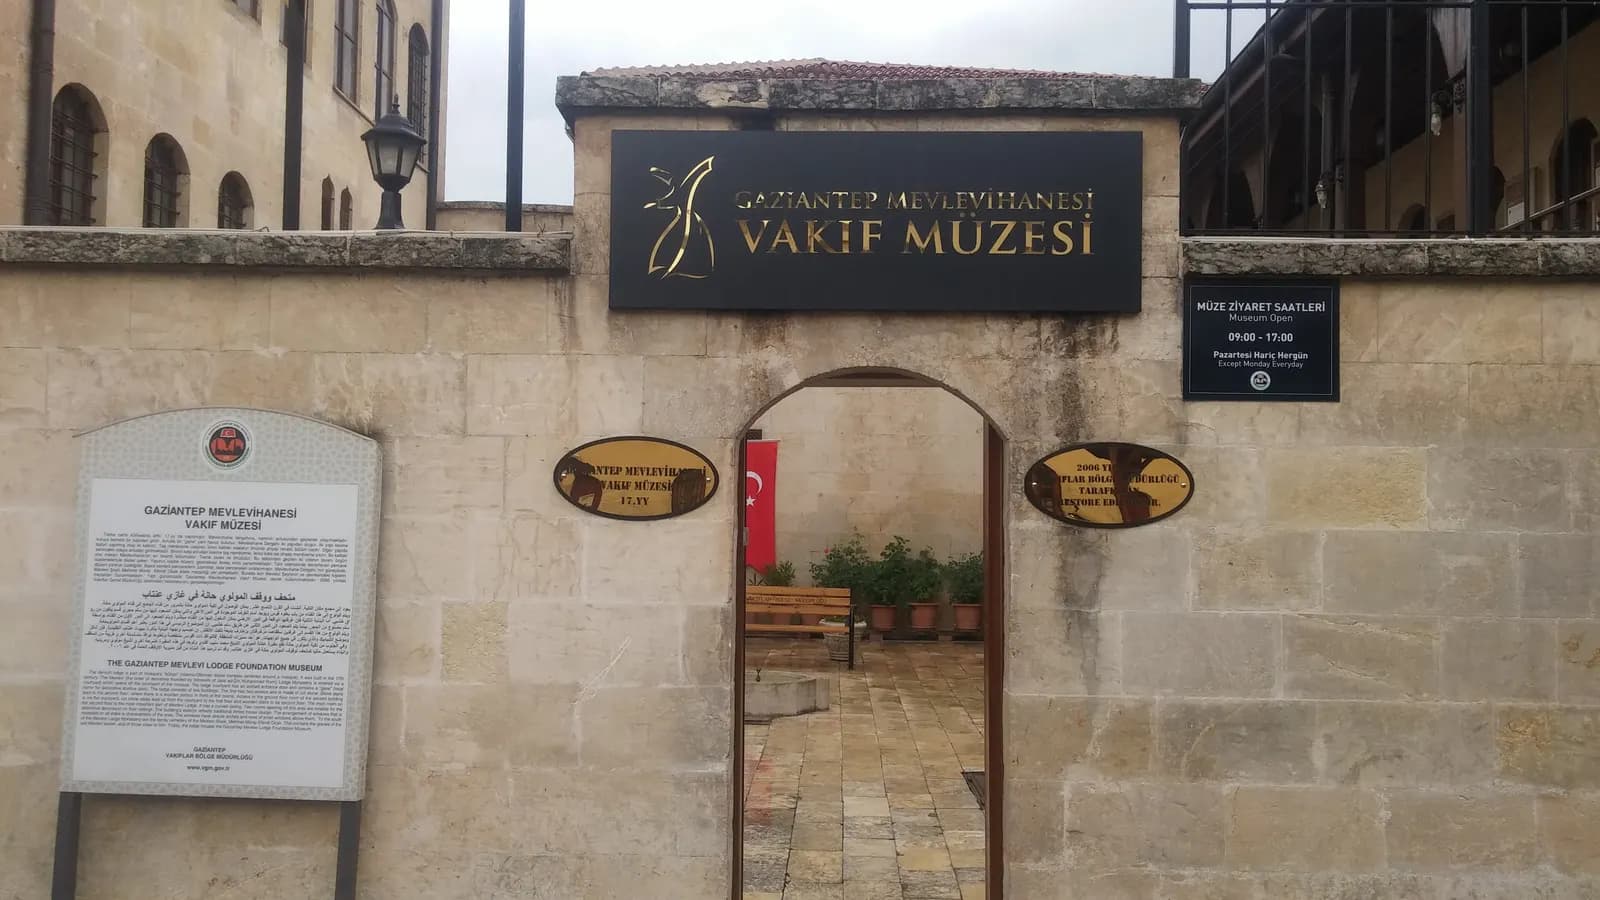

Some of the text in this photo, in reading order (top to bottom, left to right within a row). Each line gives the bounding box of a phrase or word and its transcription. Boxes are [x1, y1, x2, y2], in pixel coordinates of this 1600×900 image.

[736, 211, 1095, 256] VAKIF MÜZESİ
[1196, 300, 1326, 312] MÜZE ZİYARET SAATLERİ
[1229, 314, 1293, 324] Museum Open
[1228, 333, 1256, 342] 09:00
[1266, 333, 1294, 342] 17:00
[1213, 351, 1308, 361] Pazartesi Hariç Hergün
[1218, 360, 1304, 369] Except Monday Everyday
[1076, 464, 1100, 472] 2006
[620, 496, 650, 506] 17.YY
[185, 518, 262, 531] VAKIF MÜZESİ
[107, 659, 123, 667] THE
[206, 662, 234, 670] LODGE
[236, 662, 287, 671] FOUNDATION
[289, 664, 322, 672] MUSEUM
